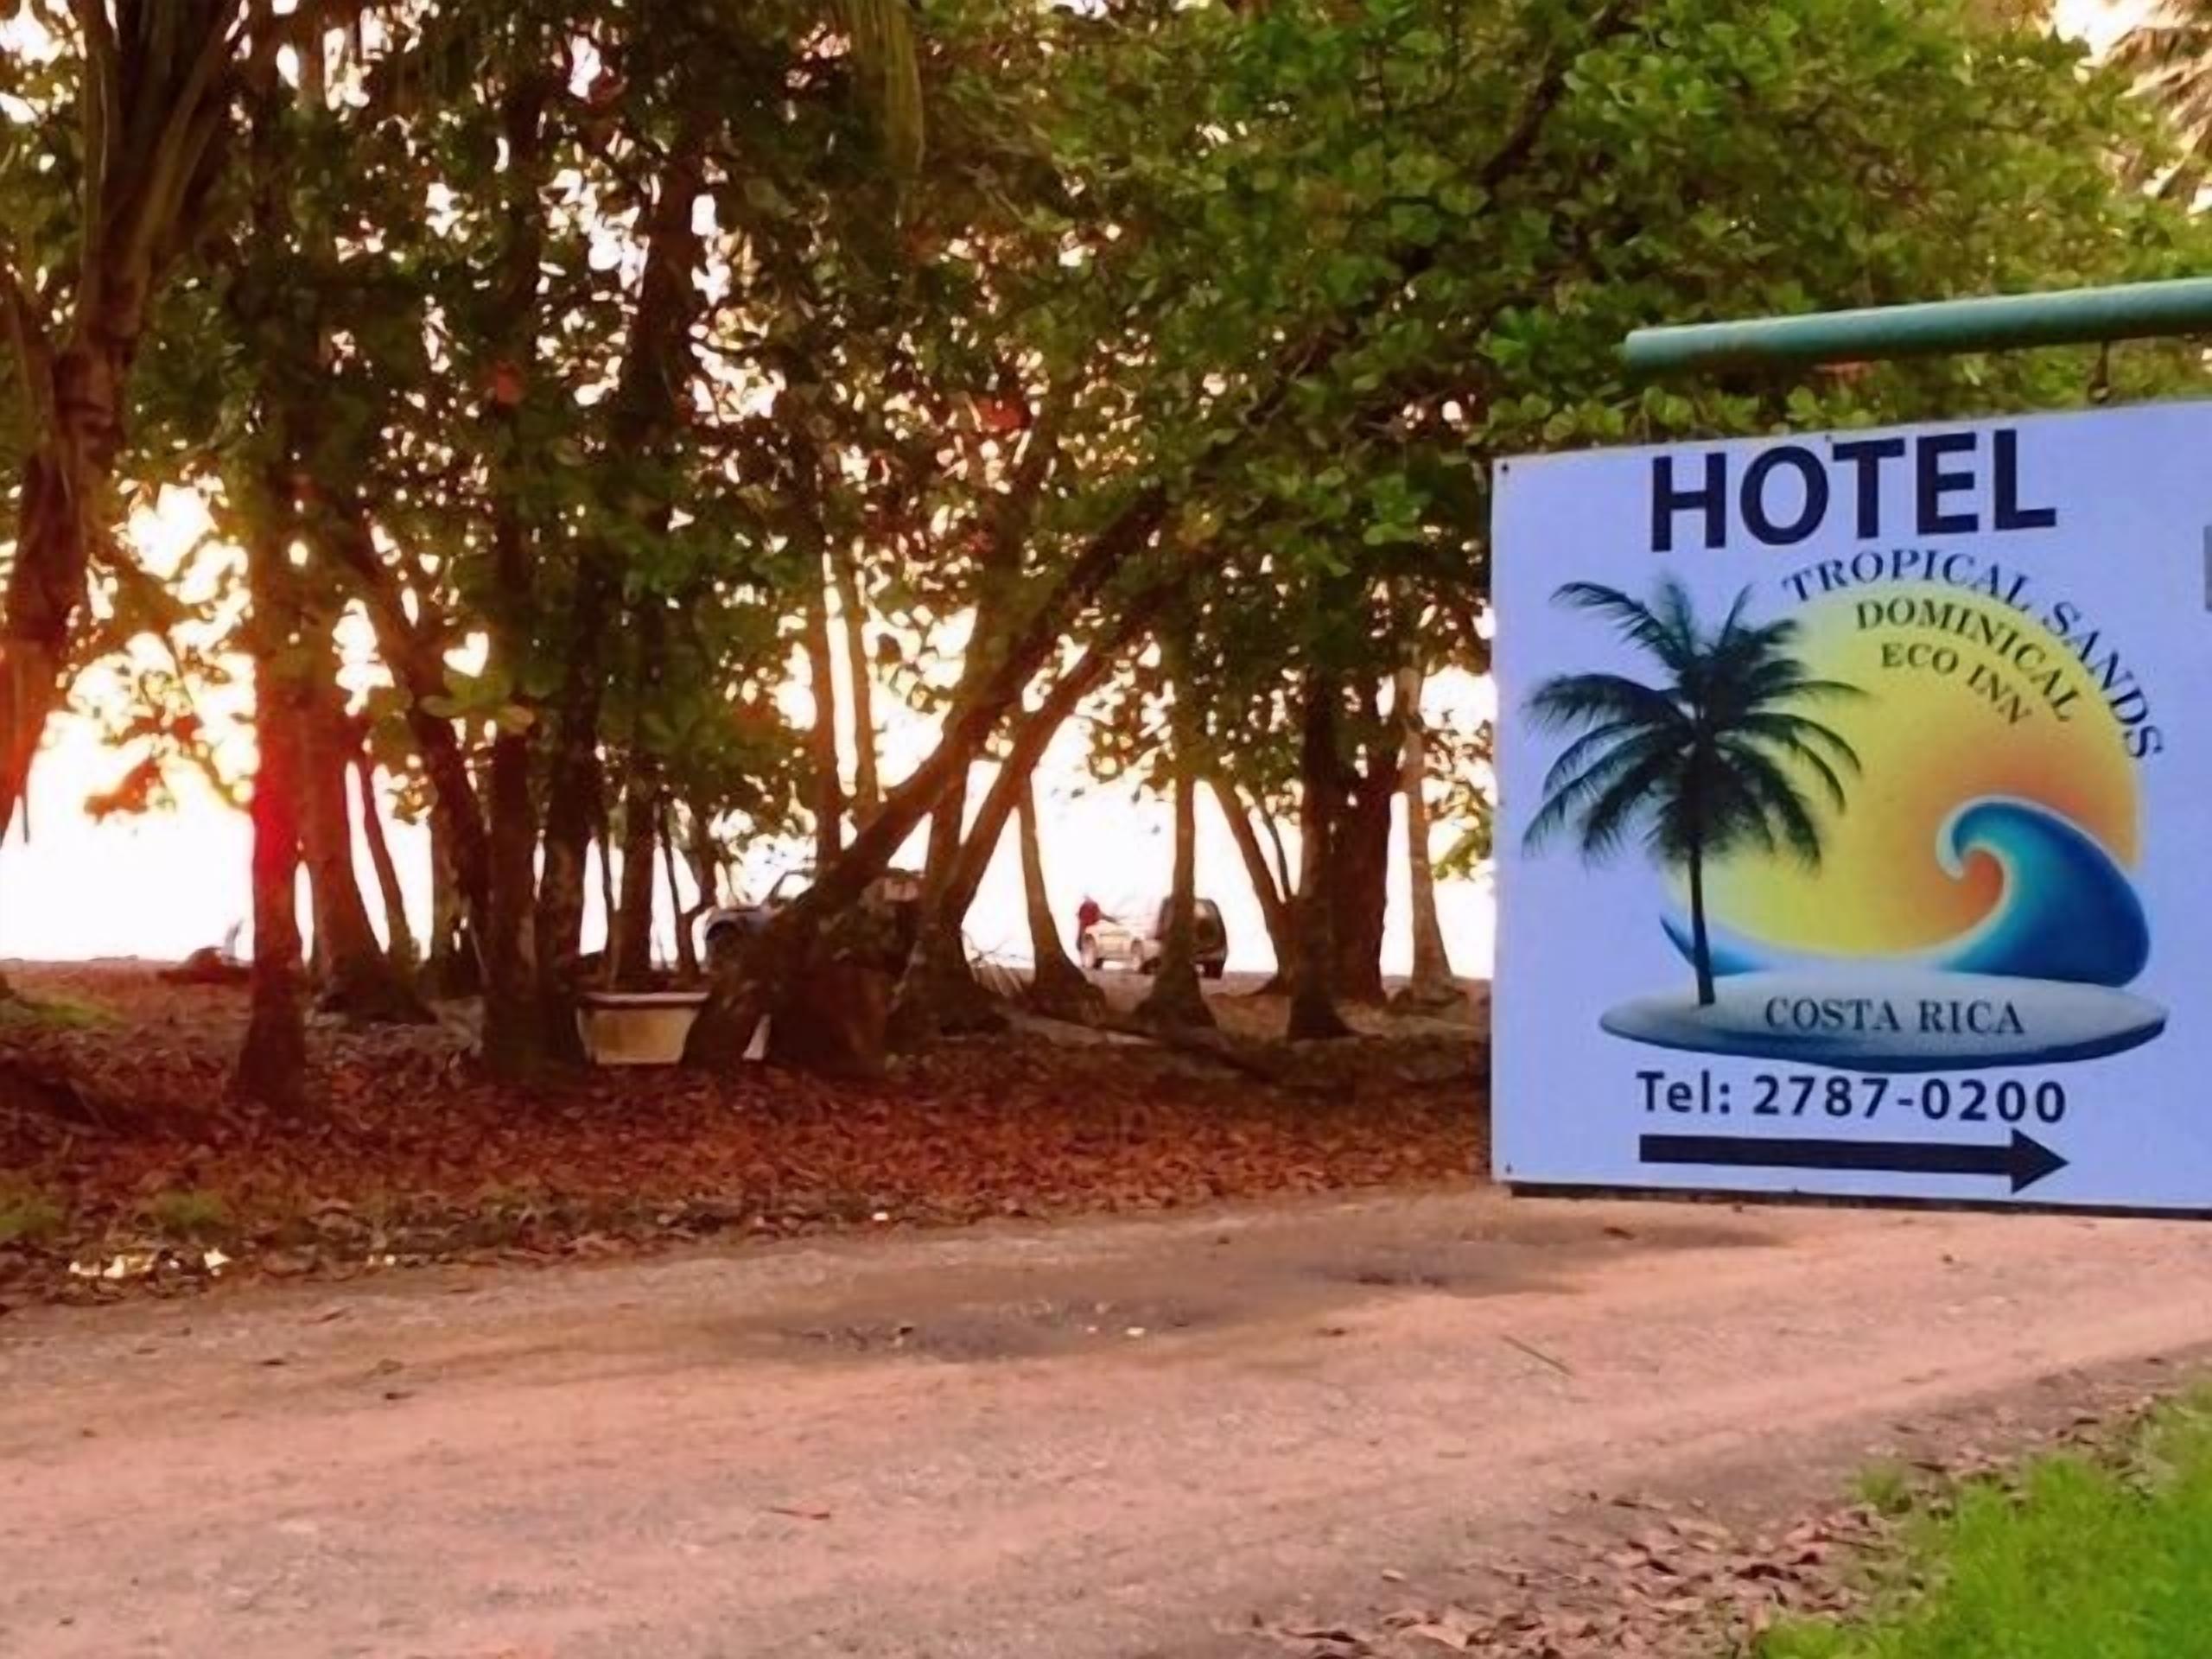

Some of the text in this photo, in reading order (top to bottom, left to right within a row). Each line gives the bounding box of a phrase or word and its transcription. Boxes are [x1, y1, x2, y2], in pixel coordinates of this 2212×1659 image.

[1651, 429, 2058, 553] HOTEL
[1782, 548, 2164, 761] TROPICAL SANDS
[1855, 597, 2080, 722] DOMINICAL
[1881, 642, 2033, 726] ECO INN
[1764, 996, 2025, 1035] COSTA RICA
[1636, 1071, 2068, 1125] Tel: 2787-0200
